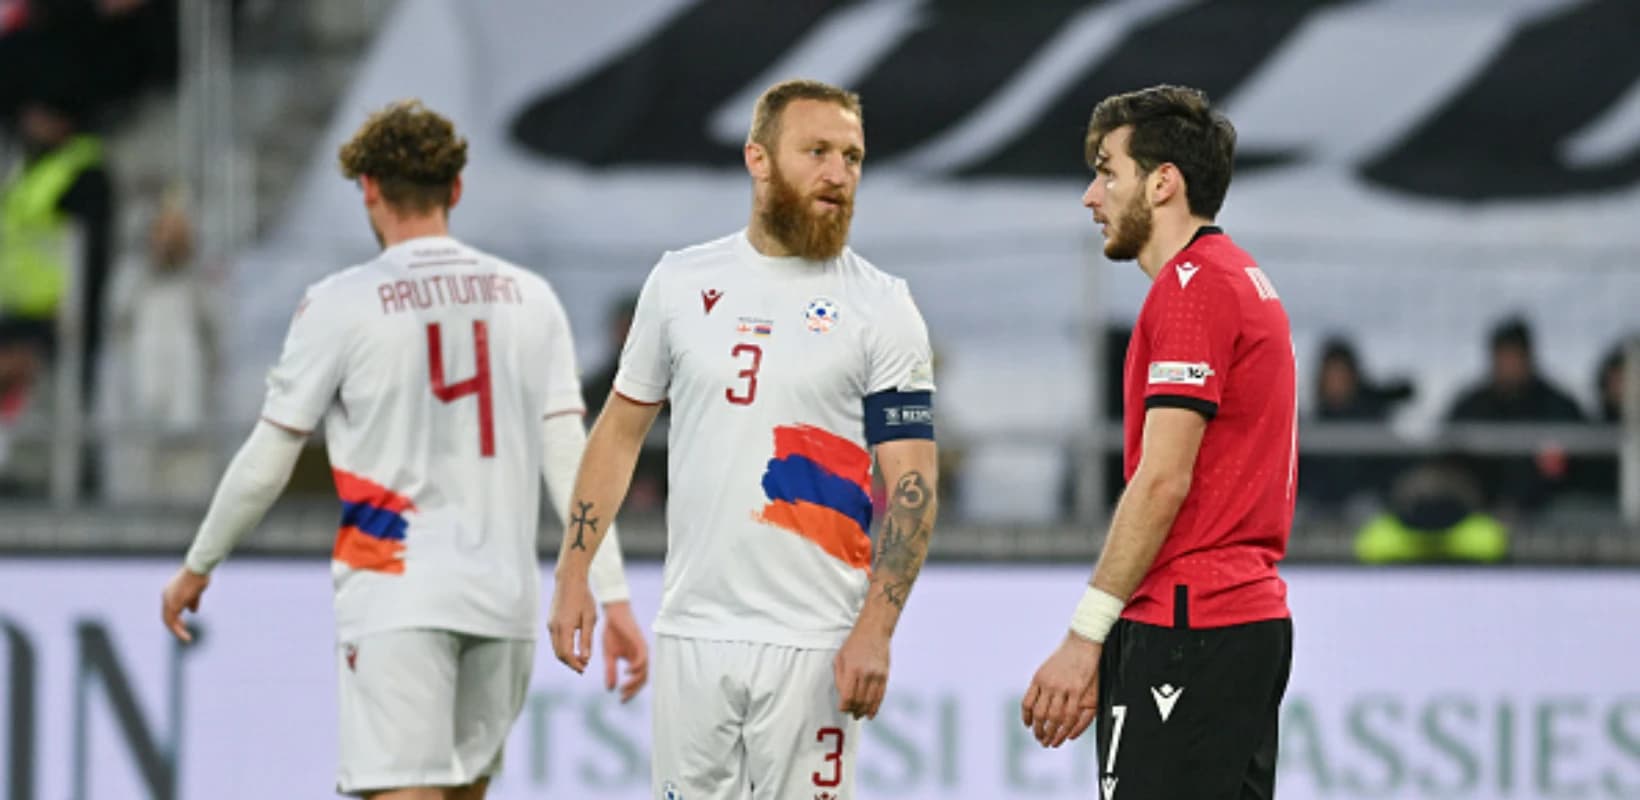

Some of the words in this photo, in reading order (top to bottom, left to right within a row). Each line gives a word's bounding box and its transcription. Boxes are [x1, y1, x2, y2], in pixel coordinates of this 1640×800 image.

[426, 318, 496, 458] 4
[725, 343, 763, 406] 3
[812, 726, 845, 788] 3
